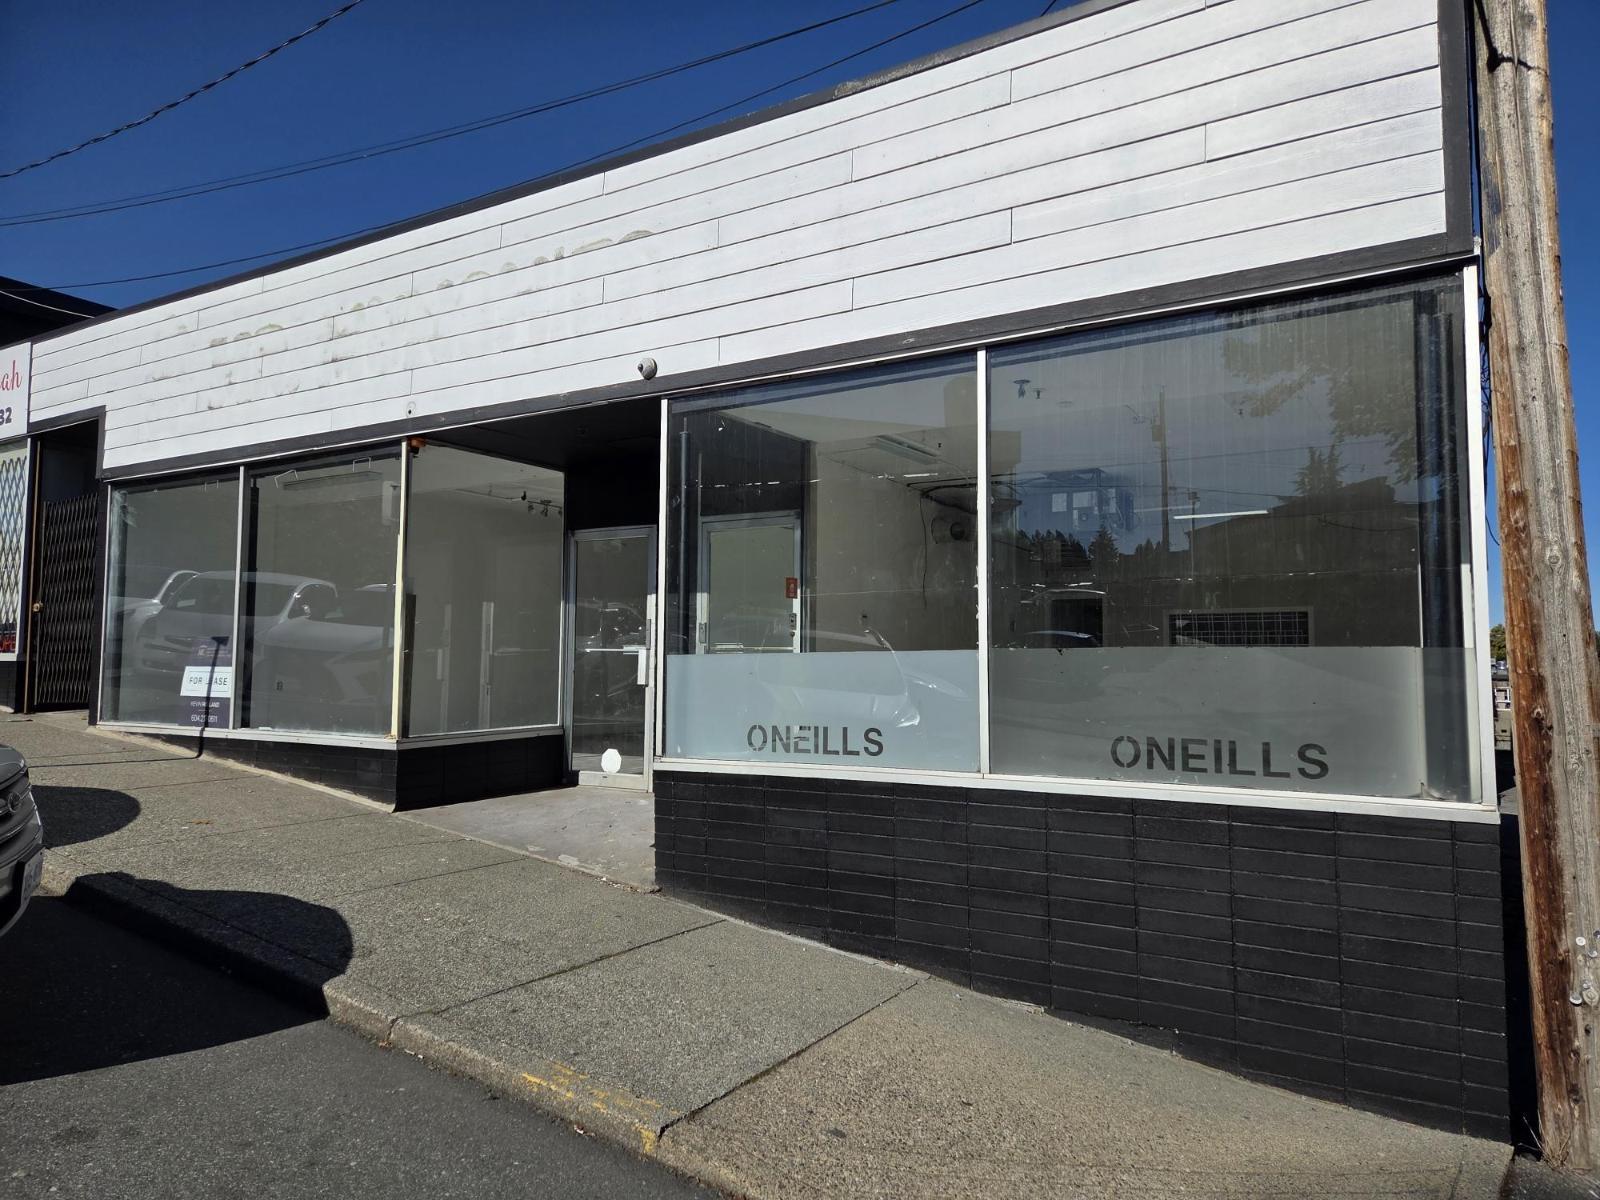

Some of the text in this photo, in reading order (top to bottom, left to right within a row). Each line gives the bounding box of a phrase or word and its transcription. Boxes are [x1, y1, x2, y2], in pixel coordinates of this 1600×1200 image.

[189, 676, 228, 686] FOR LASE
[747, 724, 884, 757] ONEILLS
[1110, 735, 1330, 780] ONEILLS
